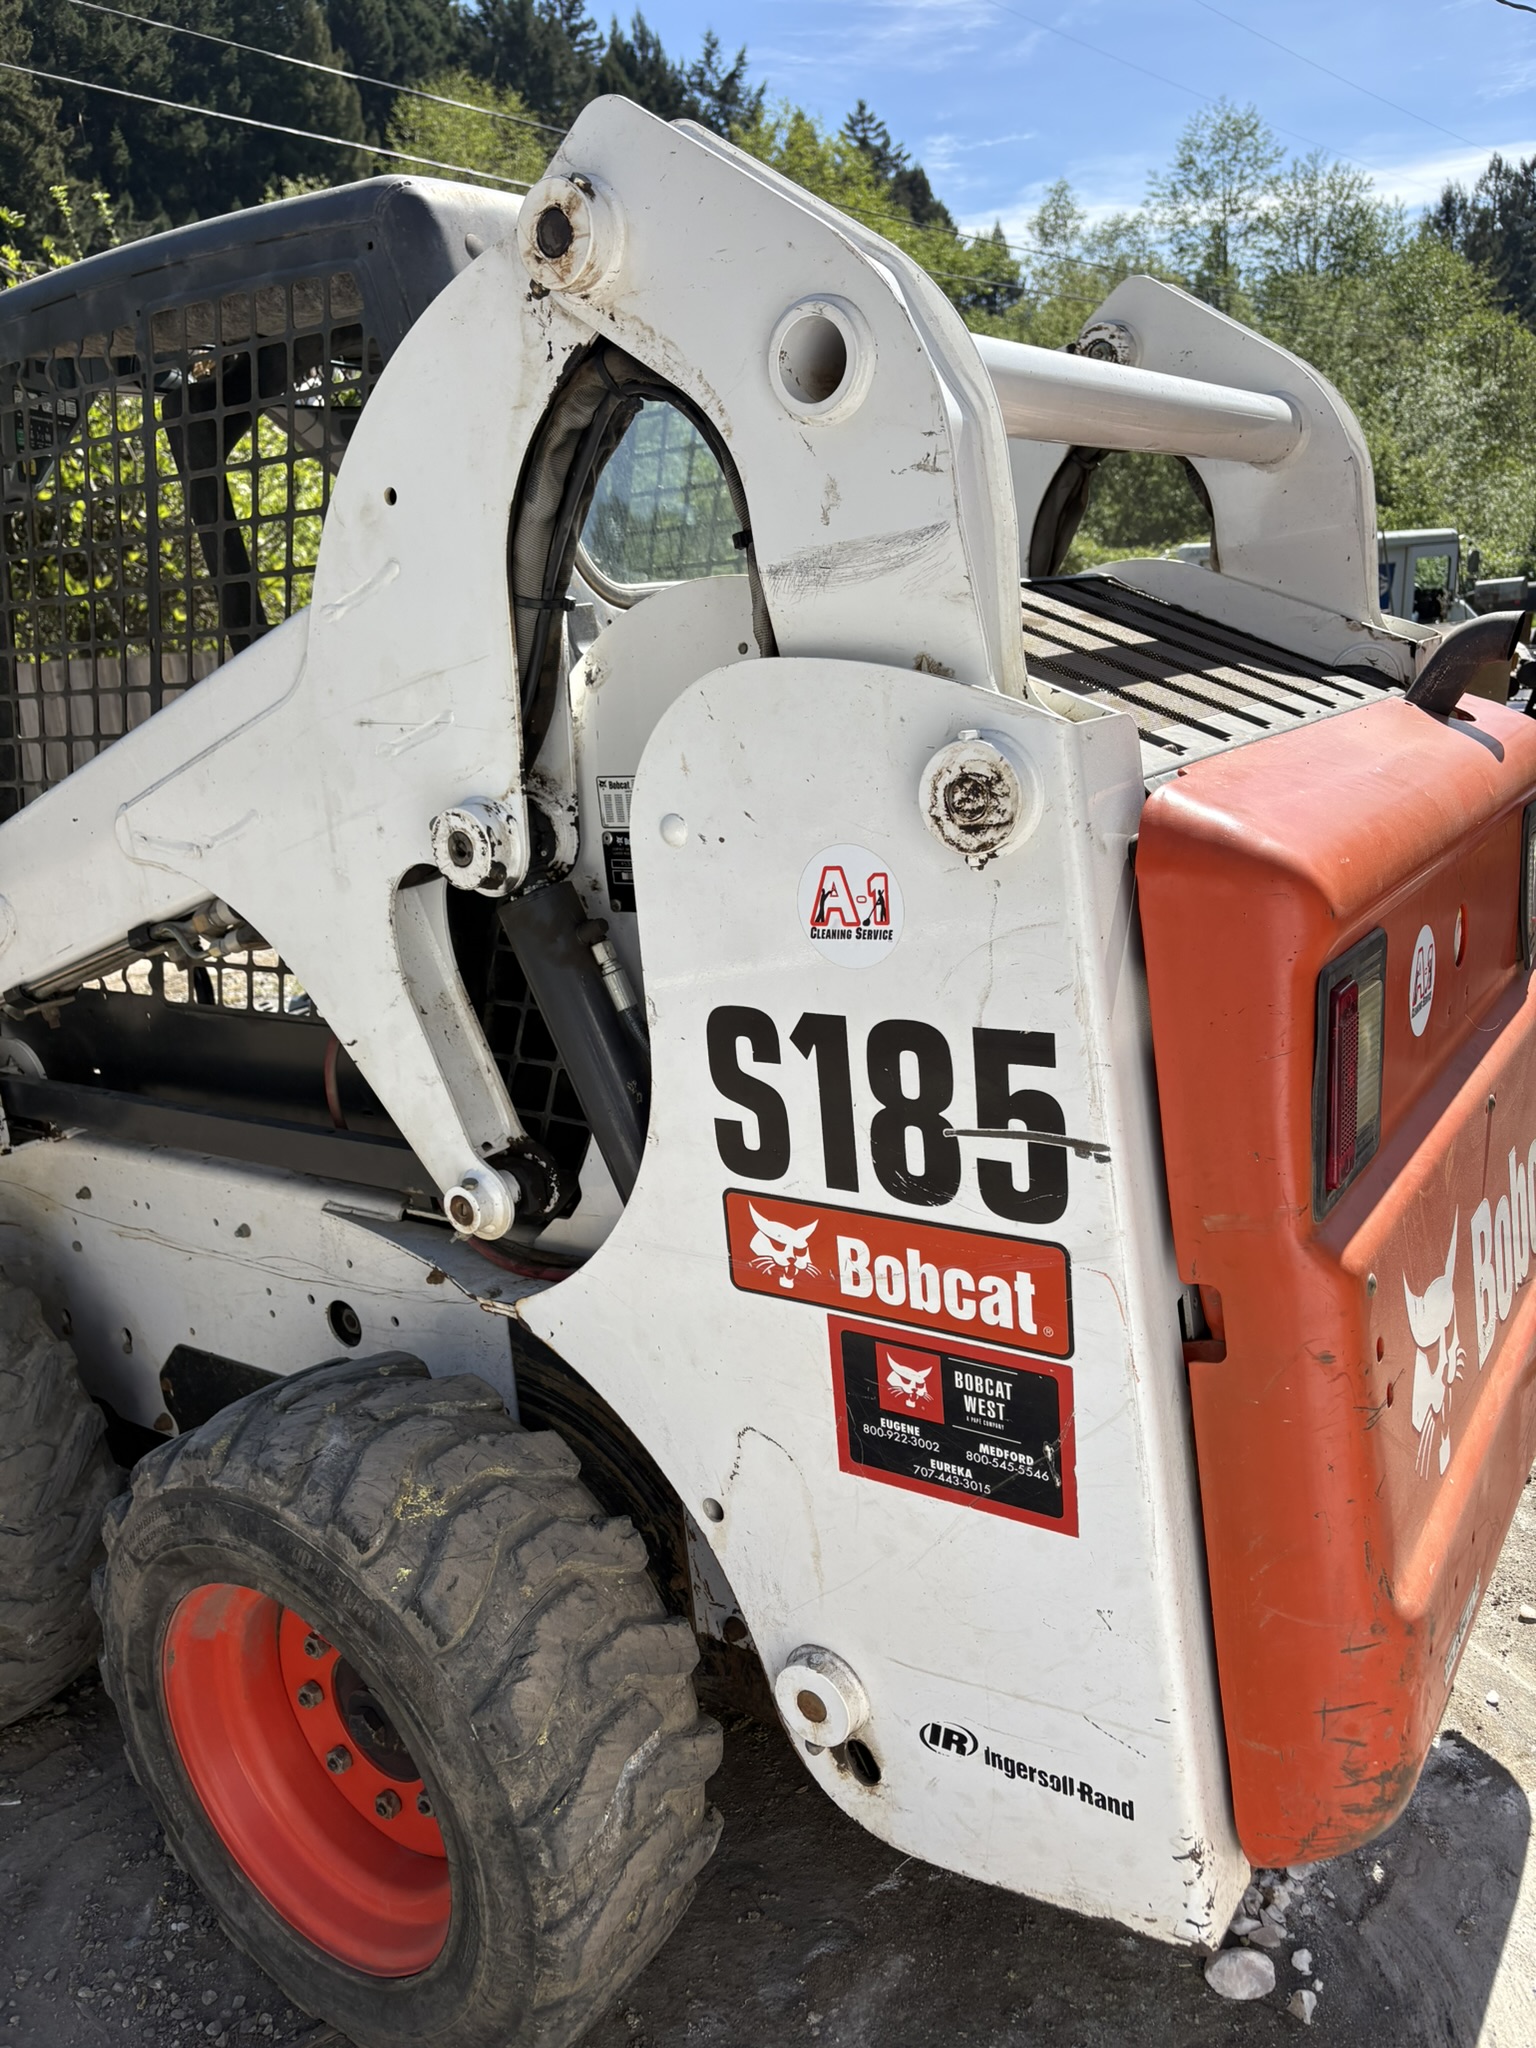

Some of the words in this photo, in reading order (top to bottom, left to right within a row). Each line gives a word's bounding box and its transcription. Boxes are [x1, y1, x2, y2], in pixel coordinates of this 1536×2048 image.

[608, 780, 630, 790] Bobcat
[810, 865, 891, 927] A-1
[810, 926, 852, 940] CLEANING
[855, 927, 893, 941] SERVICE
[706, 1005, 1069, 1225] S185
[836, 1234, 1038, 1335] Bobcat
[953, 1370, 1013, 1400] BOBCAT
[963, 1394, 1005, 1421] WEST
[863, 1423, 940, 1453] 800-922-3002
[880, 1417, 920, 1437] EUGENE
[930, 1459, 973, 1479] EUREKA
[965, 1450, 1050, 1481] 800-545-5546
[979, 1443, 1034, 1466] MEDFORD
[913, 1465, 991, 1495] 707-443-3015
[928, 1722, 968, 1757] IR
